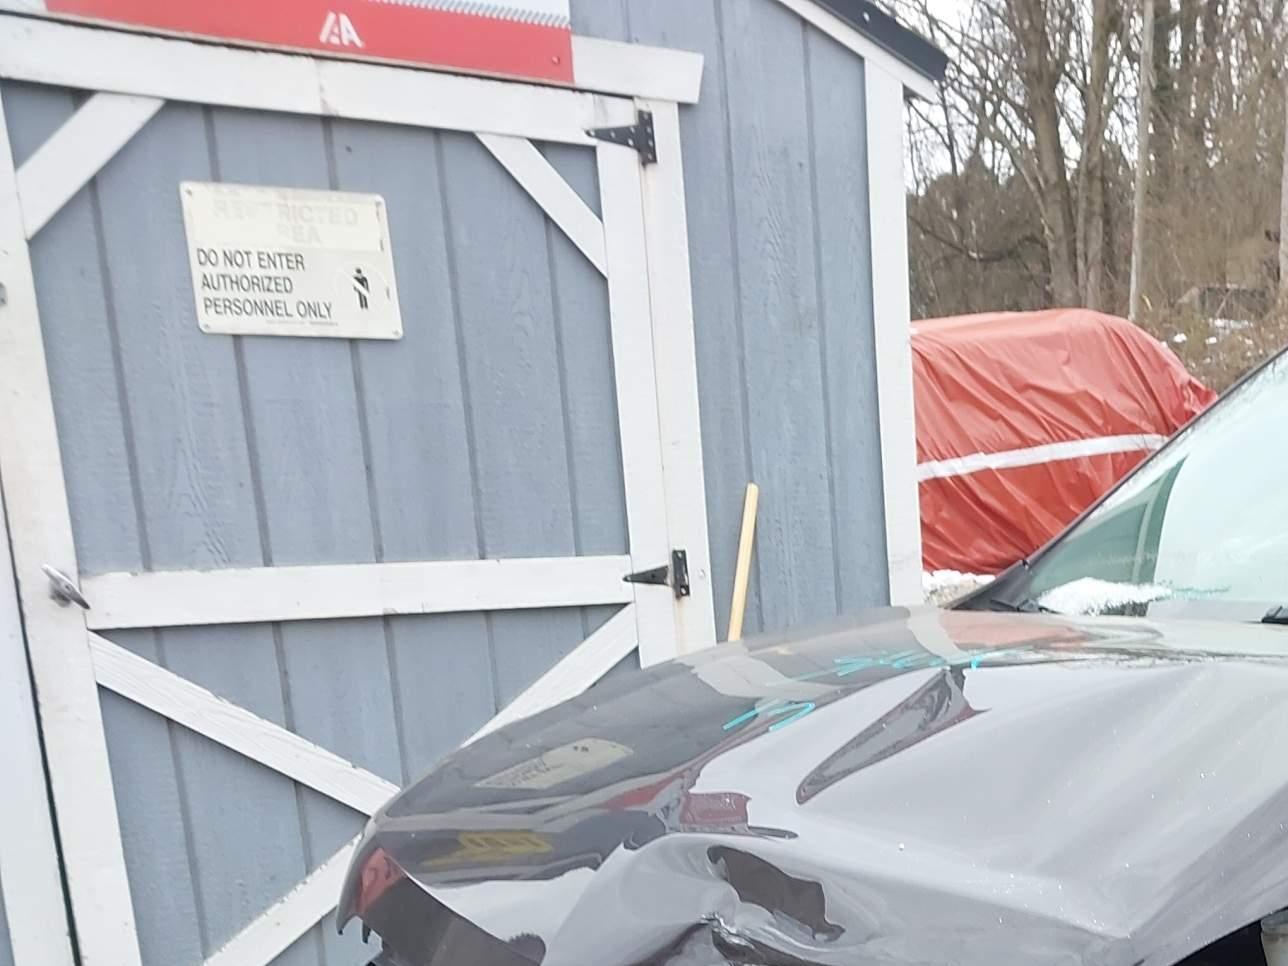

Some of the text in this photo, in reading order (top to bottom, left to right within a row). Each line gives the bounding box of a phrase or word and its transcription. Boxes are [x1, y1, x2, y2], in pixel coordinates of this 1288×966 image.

[197, 248, 305, 271] DO NOT ENTER
[201, 273, 293, 294] AUTHORIZED
[203, 297, 332, 319] PERSONNEL ONLY
